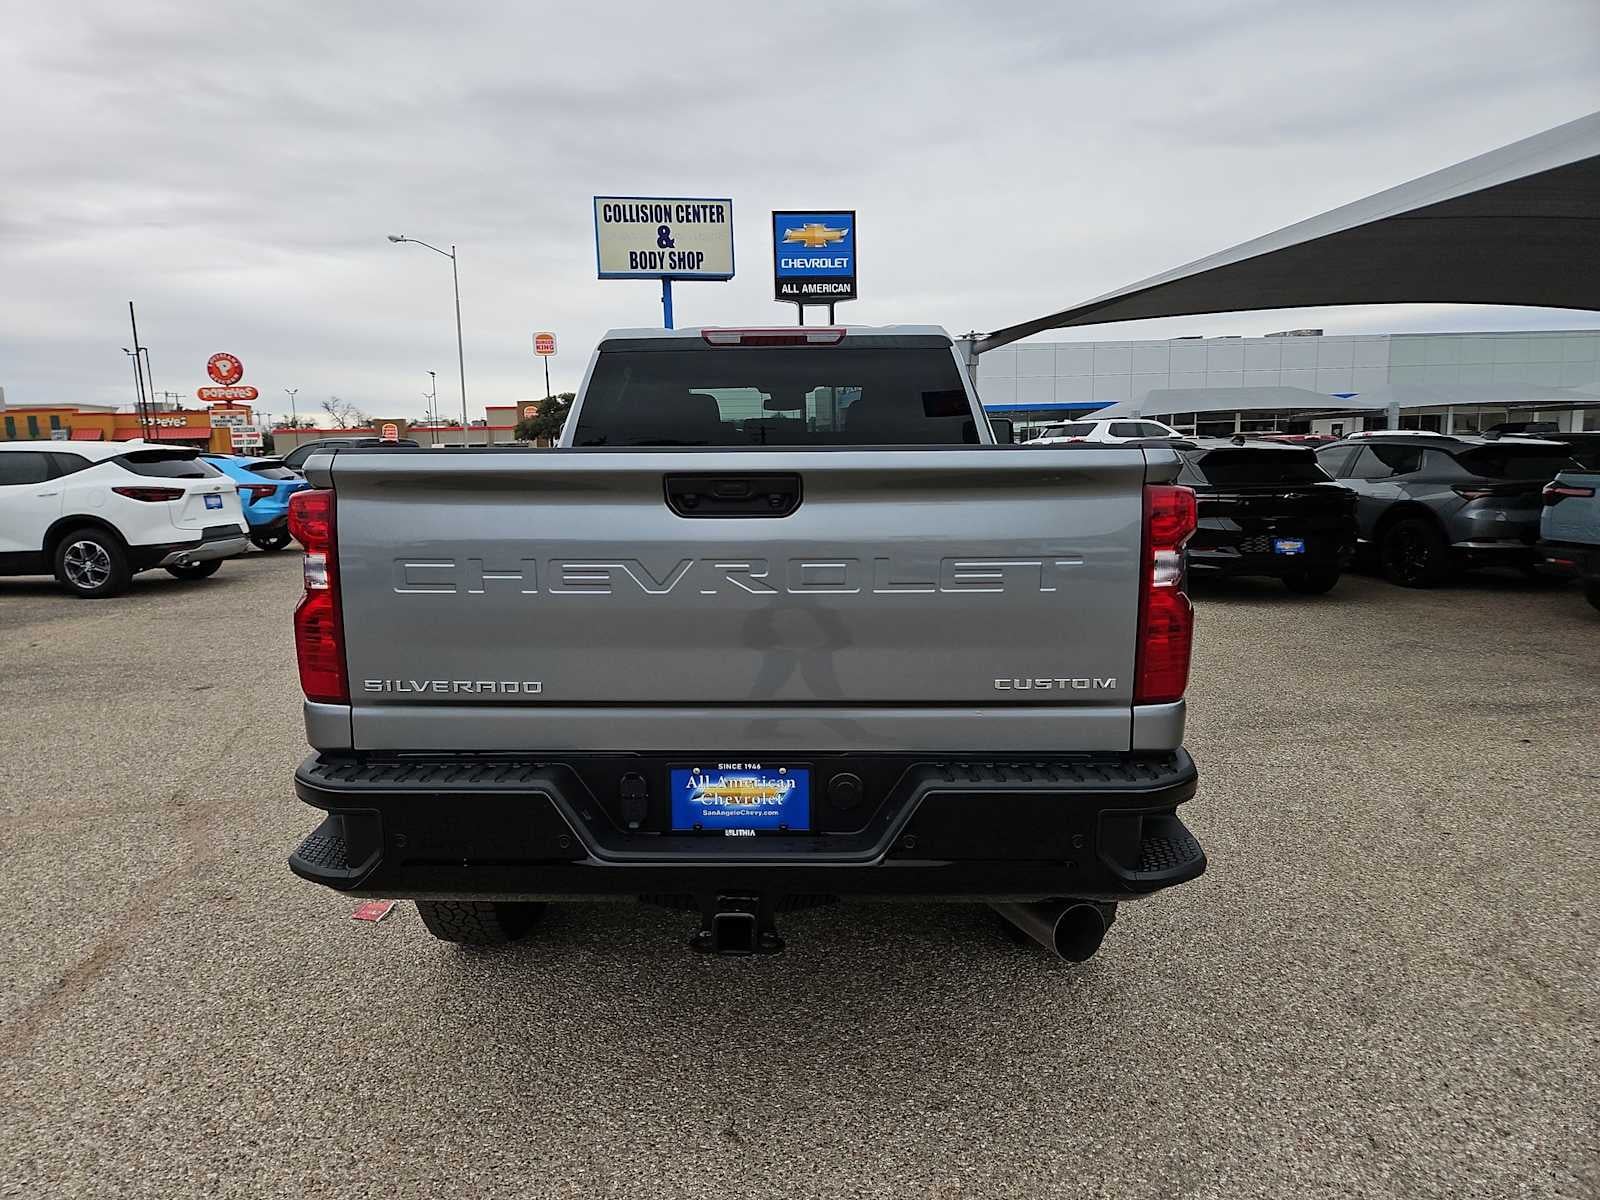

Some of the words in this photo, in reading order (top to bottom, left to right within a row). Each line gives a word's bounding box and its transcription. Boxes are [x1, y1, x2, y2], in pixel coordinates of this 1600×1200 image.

[603, 203, 672, 223] COLLISION
[675, 204, 725, 224] CENTER
[657, 225, 675, 249] &
[629, 251, 664, 270] BODY
[669, 251, 704, 270] SHOP
[781, 257, 849, 269] CHEVROLET
[781, 283, 799, 294] ALL
[801, 283, 851, 294] AMERICAN
[393, 557, 1085, 595] CHEVROLET
[364, 679, 543, 694] SILVERADO
[993, 678, 1118, 690] CUSTOM
[686, 775, 710, 789] All
[715, 775, 796, 789] American
[701, 792, 783, 806] Chevrolet
[702, 809, 779, 817] SanAngeloChevy.com
